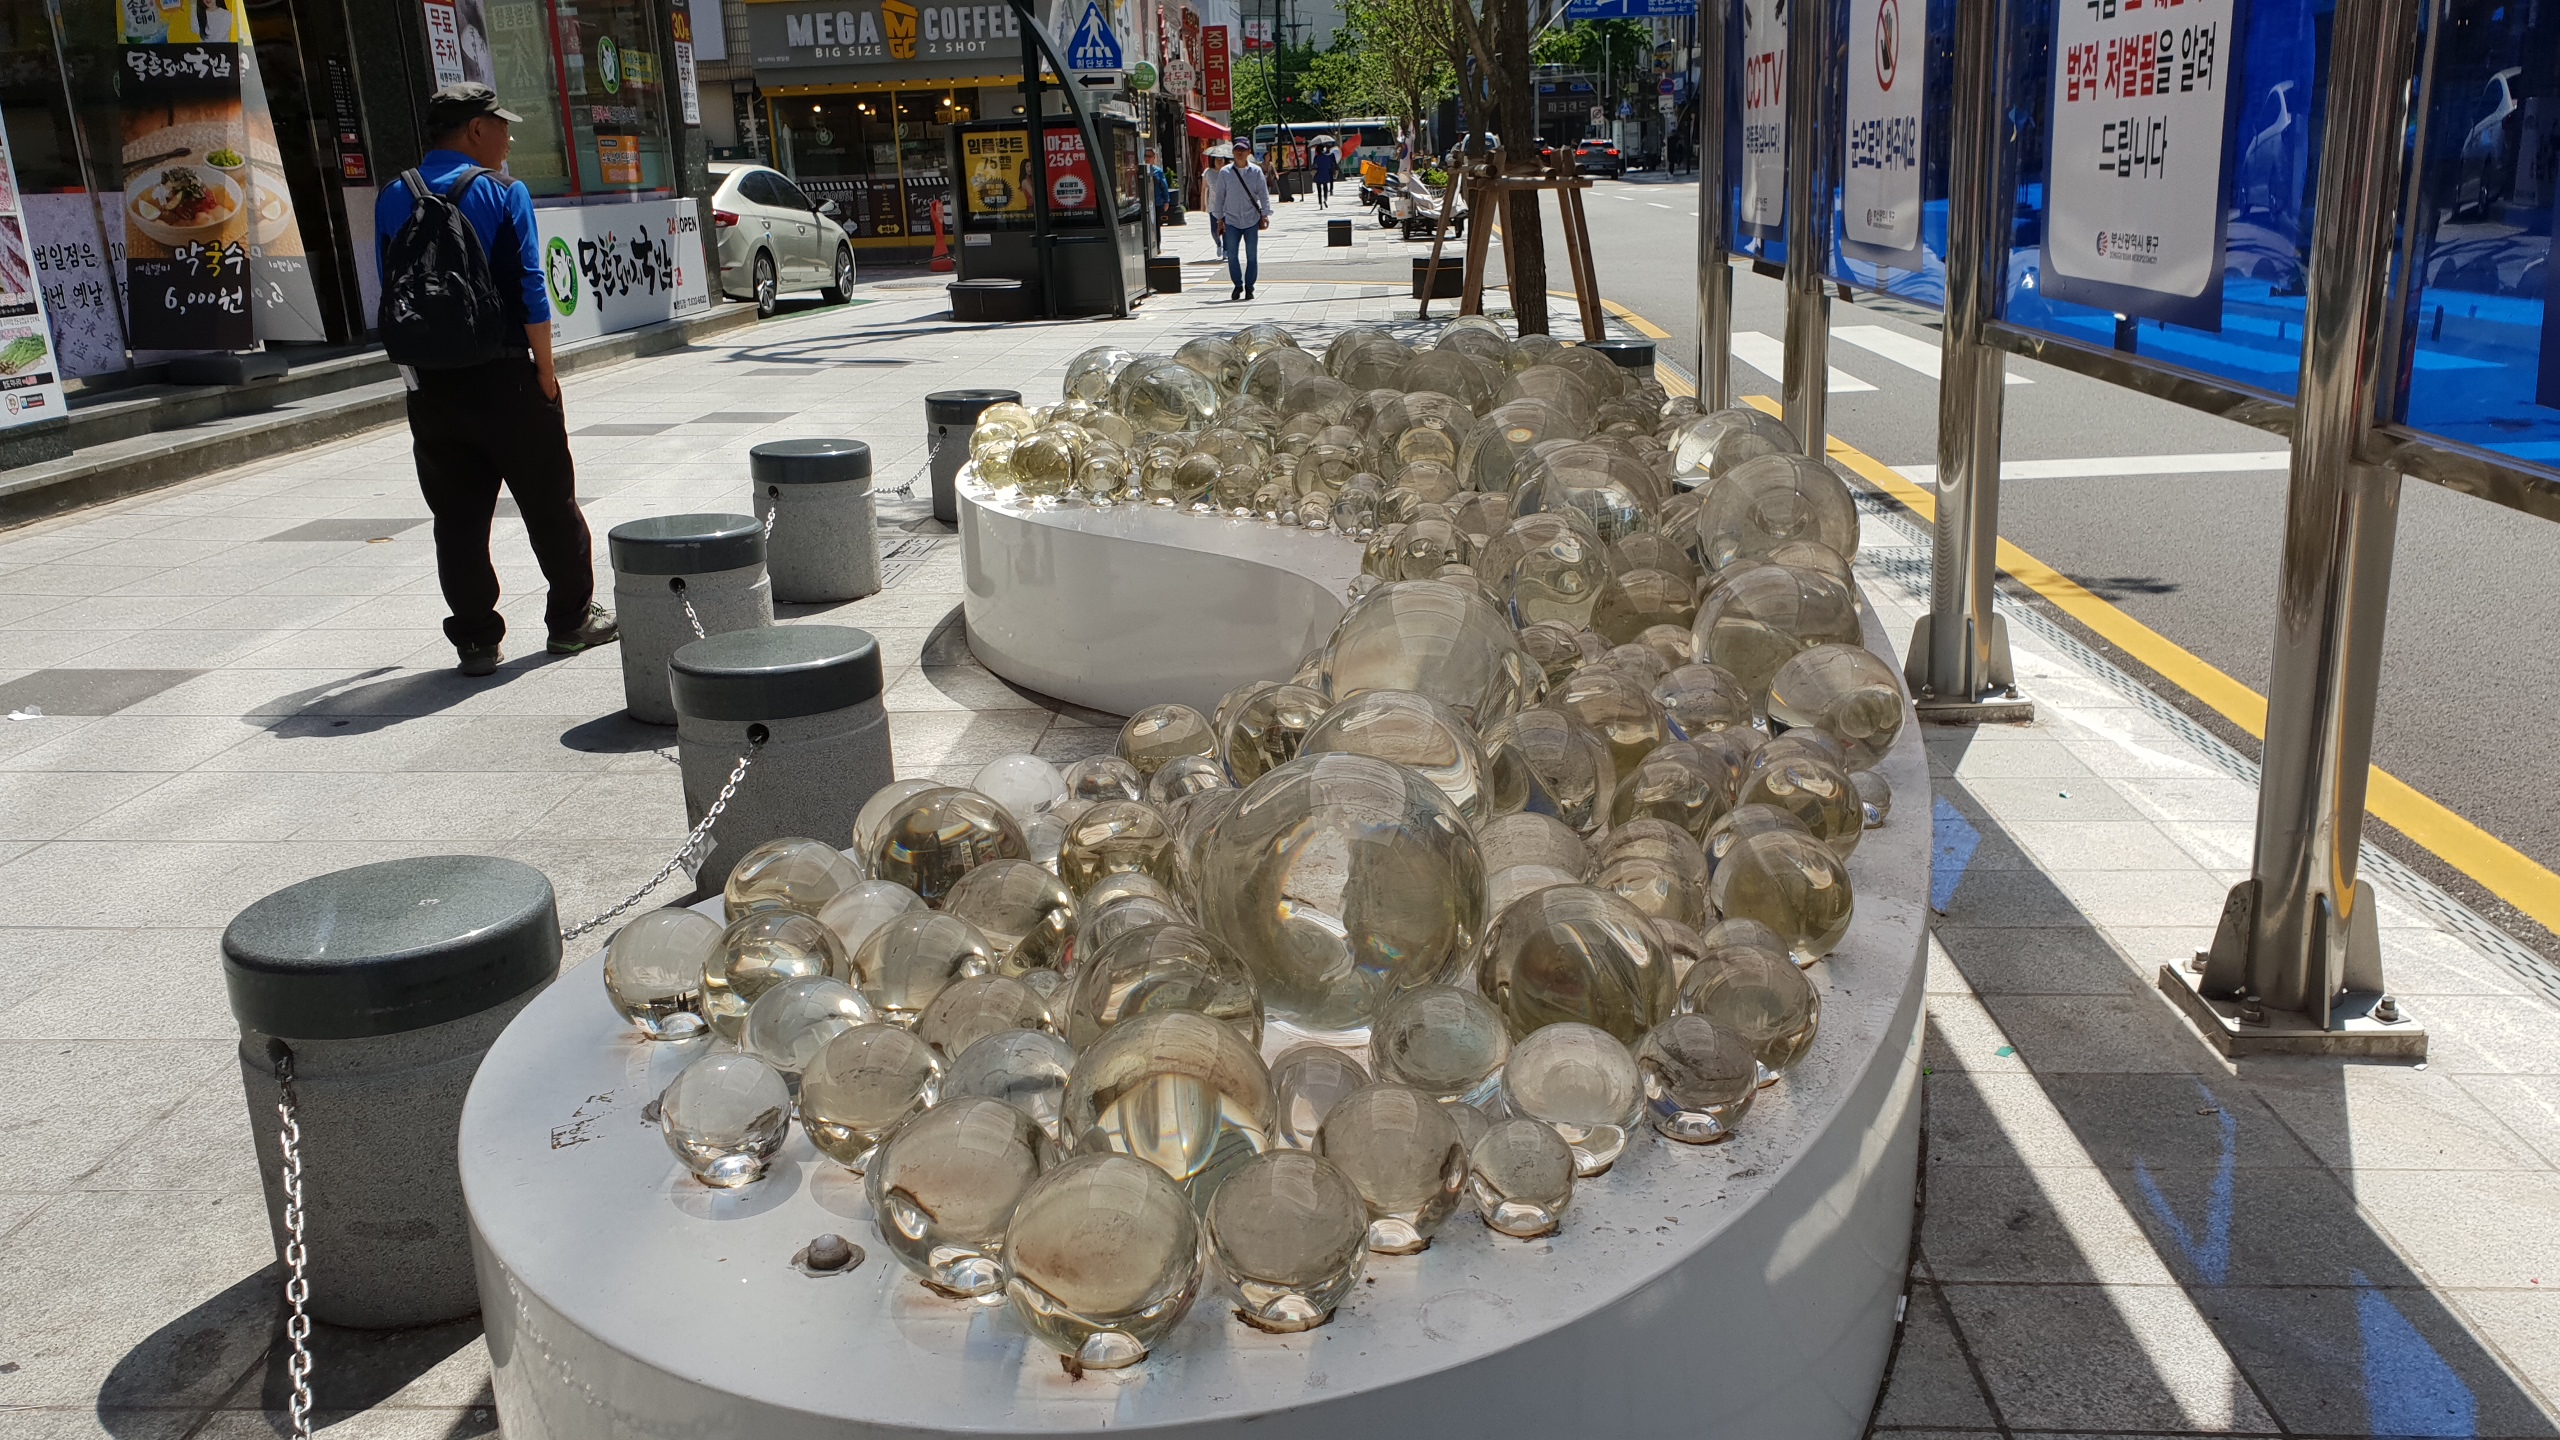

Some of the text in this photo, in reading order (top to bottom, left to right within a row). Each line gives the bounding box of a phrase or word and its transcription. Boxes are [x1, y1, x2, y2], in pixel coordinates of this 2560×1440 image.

[135, 12, 156, 25] 데이
[430, 8, 453, 35] 무료
[786, 5, 1020, 47] MEGA COFFEE
[126, 46, 231, 82] 목촌돼지국밥
[435, 39, 458, 67] 주차
[678, 45, 690, 66] 무료
[815, 41, 987, 59] BIG SIZE 2 SHOT
[1076, 59, 1115, 69] 횡단보도
[1207, 30, 1227, 96] 중국관
[2067, 21, 2217, 103] 법적 처벌됨을 알려
[681, 66, 694, 88] 주차
[1746, 49, 1784, 110] CCTV
[967, 137, 1024, 154] 임플란트
[1851, 115, 1916, 171] 눈으로만 봐주세요
[2099, 115, 2168, 180] 드립니다
[680, 215, 697, 233] OPEN
[33, 242, 96, 271] 범일점은
[2110, 232, 2159, 254] 부산광역시 동구
[174, 240, 245, 278] 막국수
[577, 224, 674, 312] 목촌돼지국밥
[73, 280, 104, 309] 옛날
[164, 284, 245, 316] 6,000원
